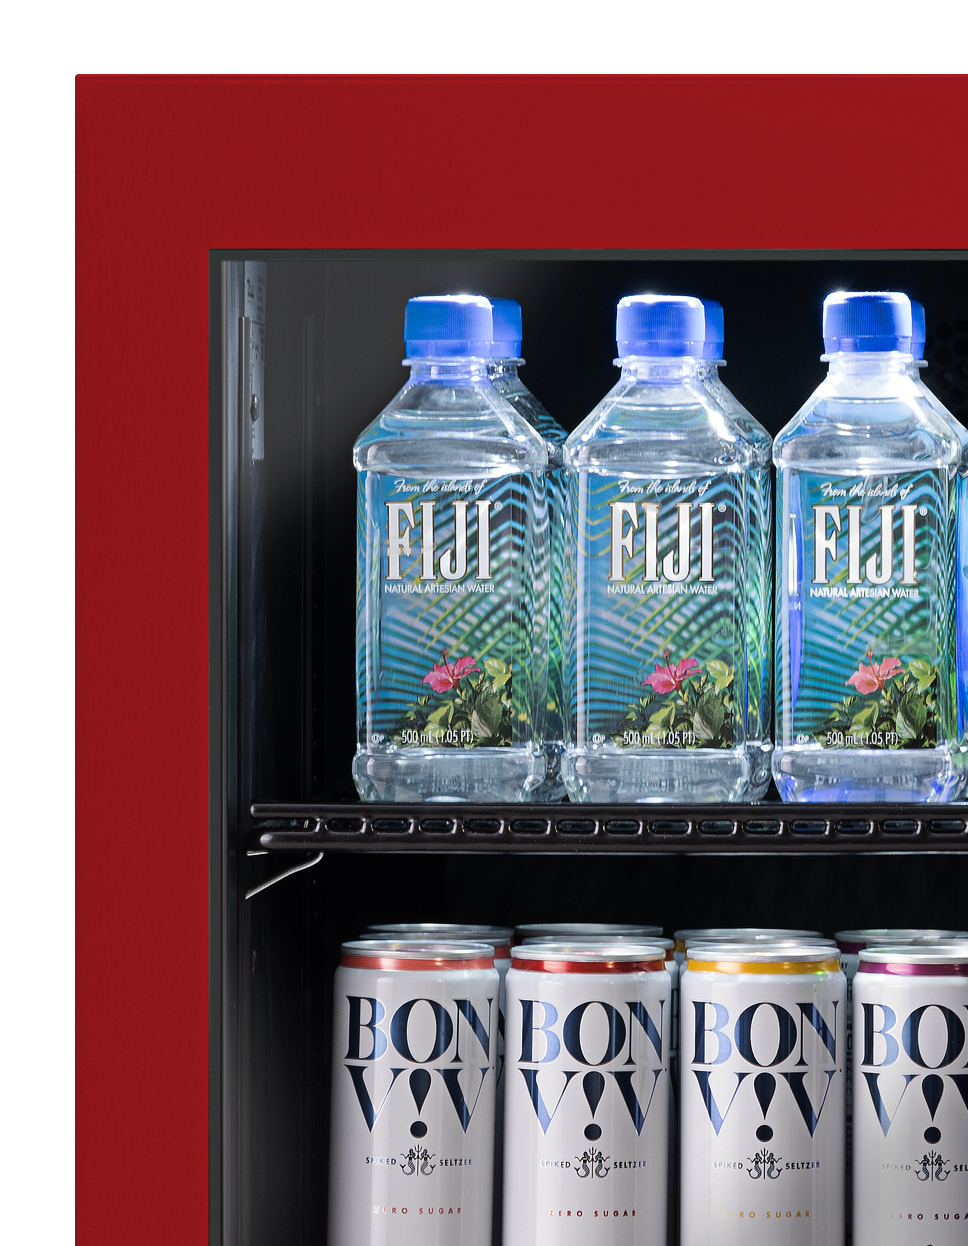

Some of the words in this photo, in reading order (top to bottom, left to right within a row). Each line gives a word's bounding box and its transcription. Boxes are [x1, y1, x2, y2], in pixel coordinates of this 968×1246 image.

[394, 479, 420, 493] From
[422, 479, 440, 493] the
[441, 479, 471, 493] islands
[473, 479, 488, 495] of
[618, 480, 643, 494] From
[646, 479, 662, 494] the
[665, 480, 695, 494] islands
[698, 480, 712, 496] of
[821, 482, 846, 496] From
[850, 482, 865, 496] the
[868, 483, 897, 497] islands
[900, 483, 913, 499] of
[384, 501, 493, 580] FIJI
[608, 502, 716, 582] FIJI
[812, 505, 918, 584] FIJI
[385, 583, 422, 593] NATURAL
[424, 583, 465, 593] ARTESIAN
[467, 583, 494, 593] WATER
[607, 584, 645, 595] NATURAL
[647, 584, 688, 595] ARTESIAN
[690, 584, 717, 595] WATER
[810, 587, 848, 598] NATURAL
[850, 587, 890, 598] ARTESIAN
[892, 588, 918, 598] WATER
[402, 730, 418, 744] 500
[435, 730, 458, 745] (1.05
[460, 730, 474, 745] PT)
[623, 730, 639, 745] 500
[657, 730, 681, 746] (1.05
[682, 730, 696, 745] PT)
[827, 731, 843, 745] 500
[860, 730, 882, 746] (1.05
[884, 730, 899, 746] PT)
[345, 995, 494, 1063] BON
[518, 999, 666, 1066] BON
[692, 1000, 840, 1068] BON
[786, 1162, 820, 1170] SELTZER
